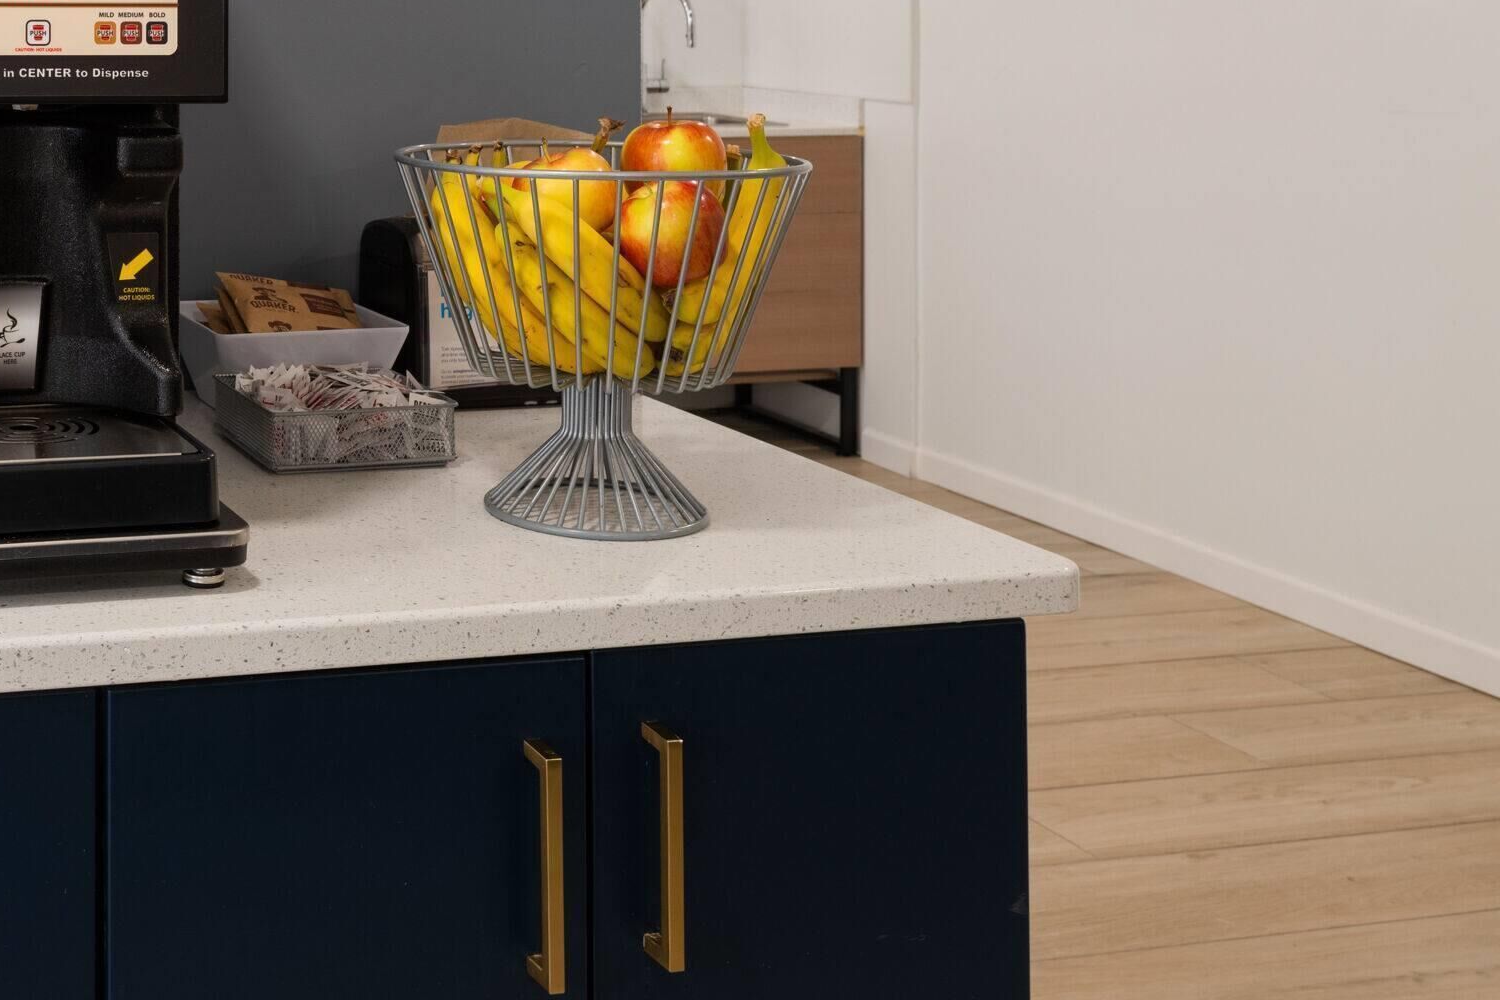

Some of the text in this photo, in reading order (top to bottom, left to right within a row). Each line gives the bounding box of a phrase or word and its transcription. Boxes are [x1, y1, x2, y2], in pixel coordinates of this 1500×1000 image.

[3, 67, 15, 78] in
[18, 67, 71, 78] CENTER
[75, 68, 89, 78] to
[92, 67, 149, 80] Dispense
[250, 300, 297, 313] QUAKER
